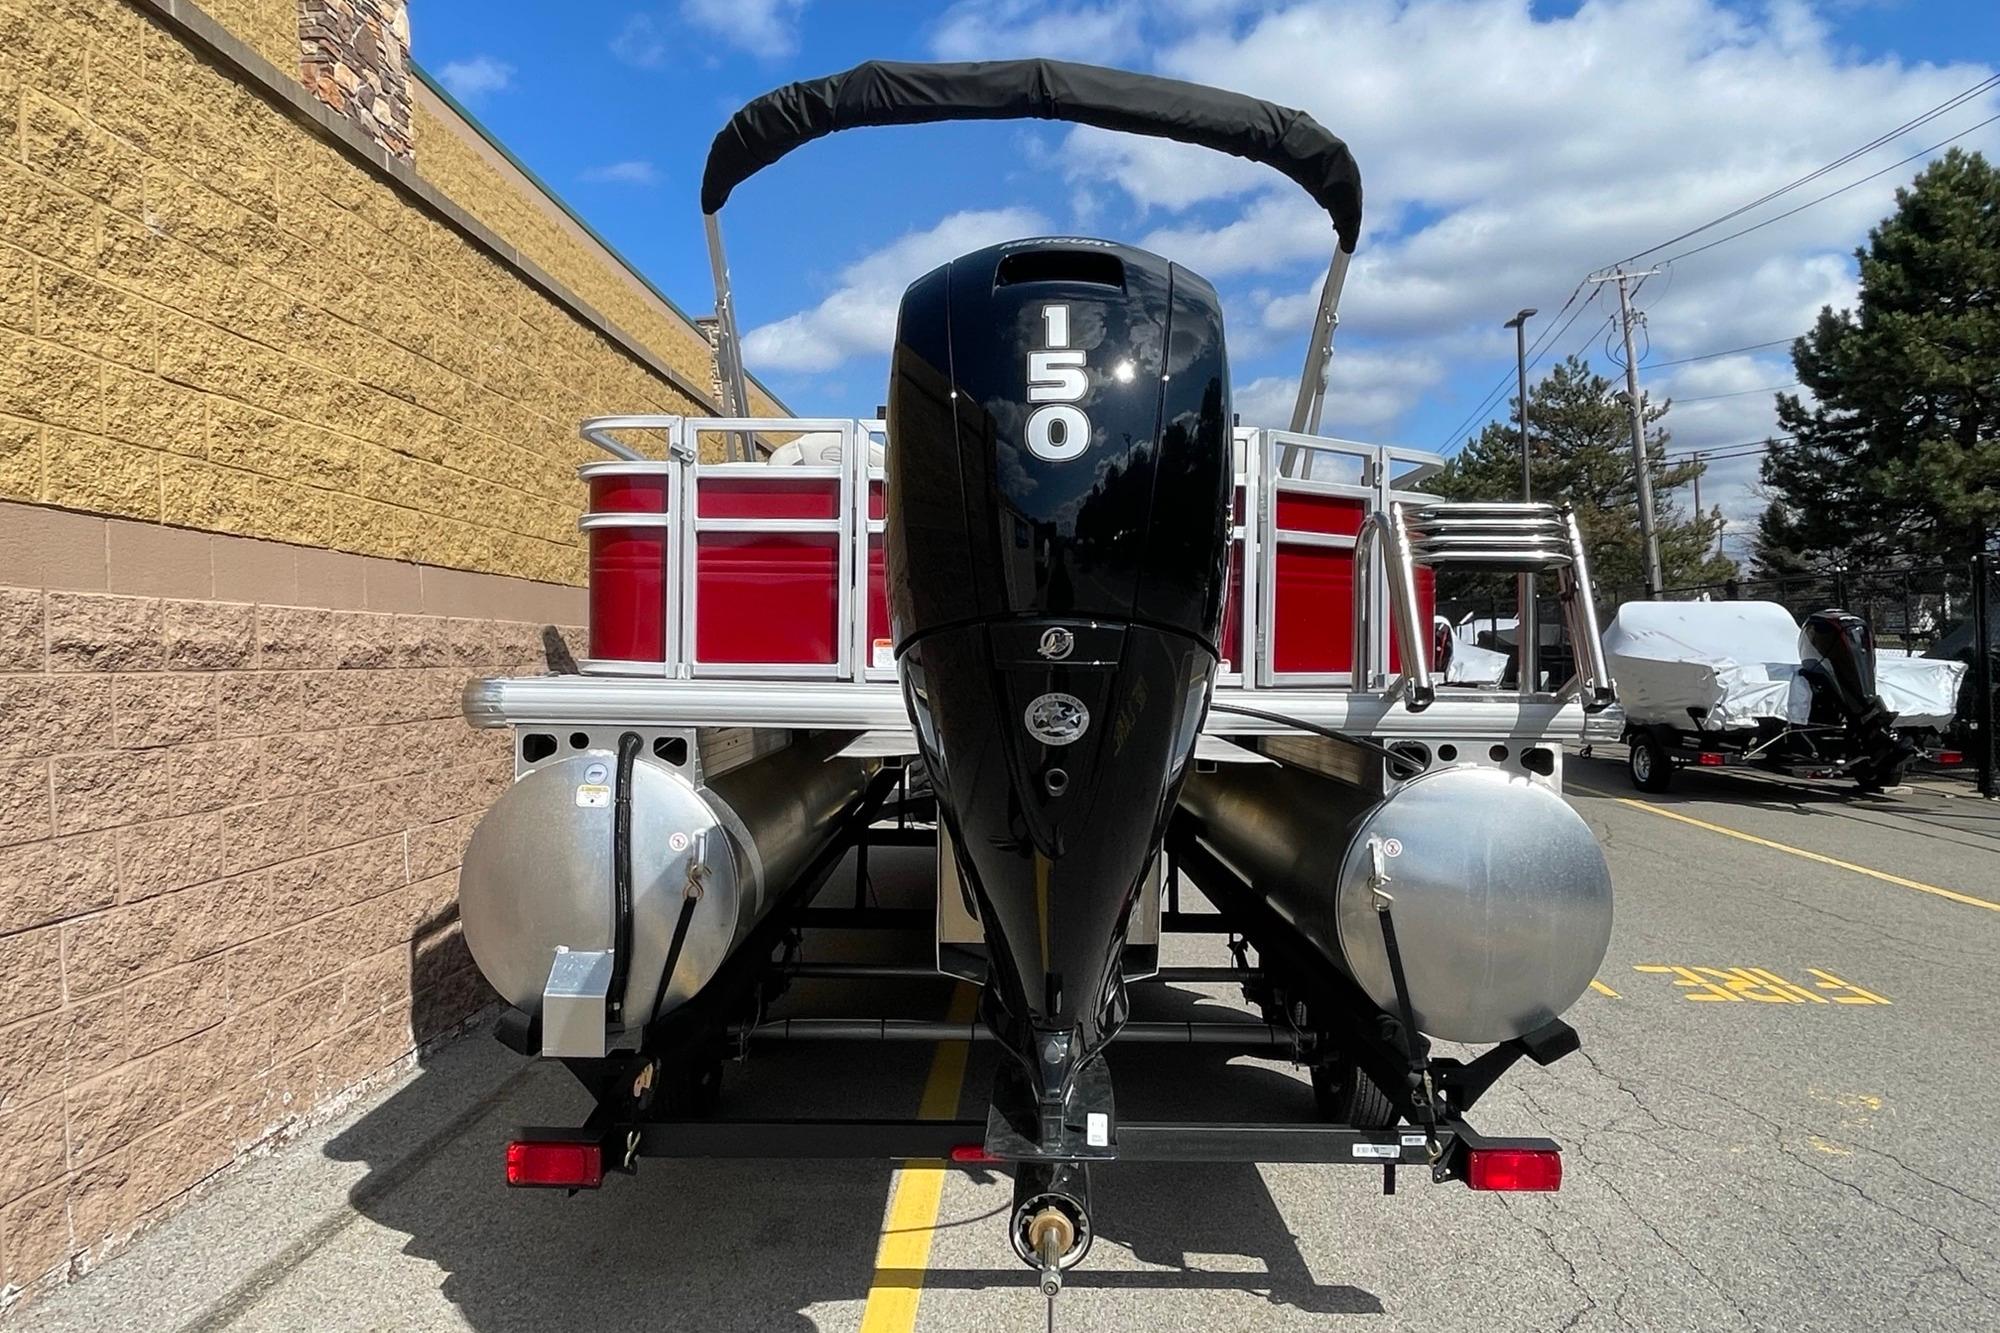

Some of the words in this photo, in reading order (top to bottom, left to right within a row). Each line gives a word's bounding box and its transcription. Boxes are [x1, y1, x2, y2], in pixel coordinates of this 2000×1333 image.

[999, 237, 1119, 250] MERCURY
[1024, 304, 1092, 462] 150
[1632, 965, 1893, 1005] FIRE
